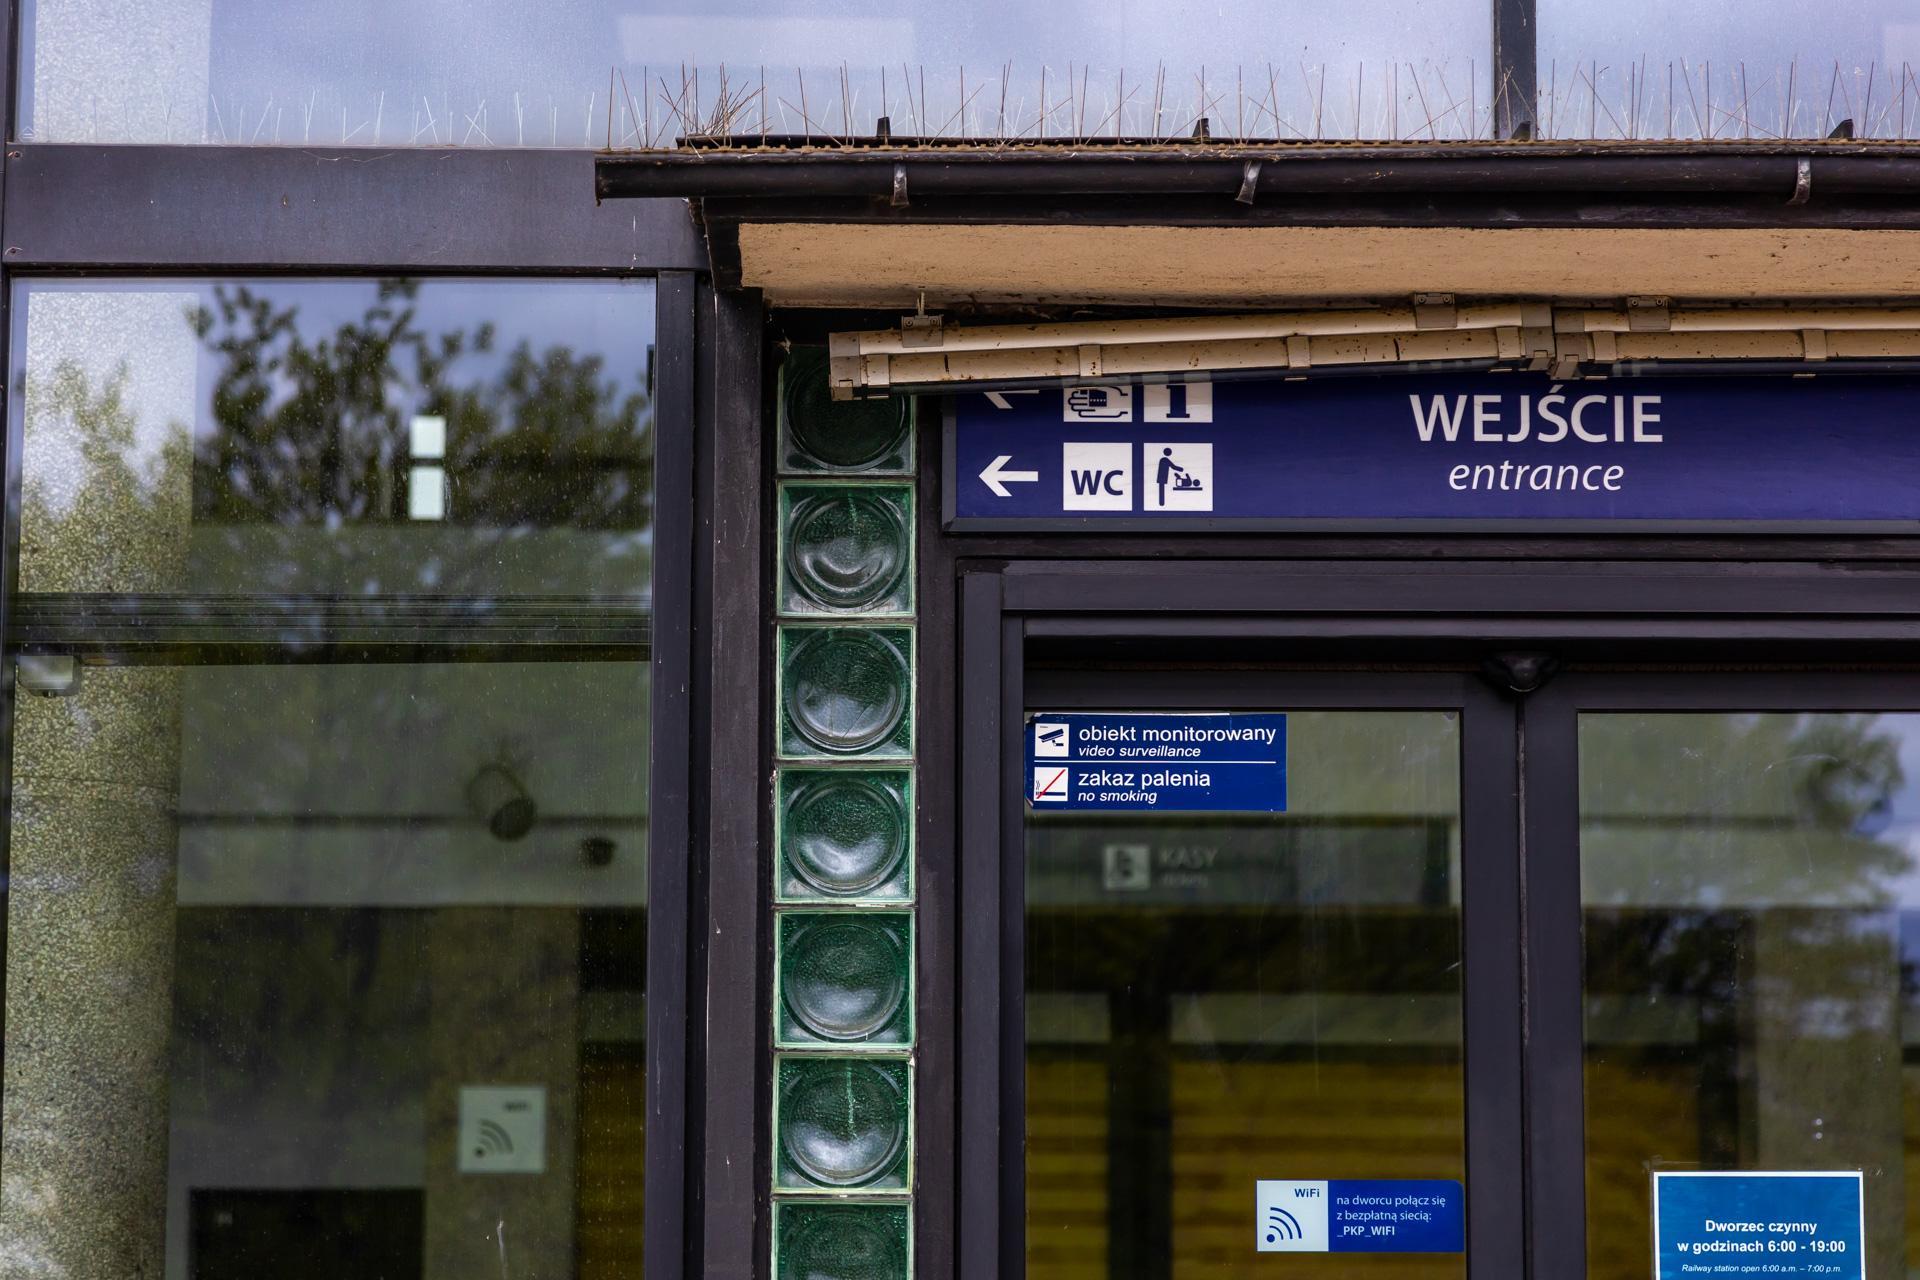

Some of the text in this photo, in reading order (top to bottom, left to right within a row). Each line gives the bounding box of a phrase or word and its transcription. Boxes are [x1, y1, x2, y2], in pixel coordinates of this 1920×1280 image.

[1409, 384, 1663, 443] WEJŚCIE
[1448, 459, 1625, 491] entrance
[1070, 469, 1124, 496] WC
[1079, 725, 1277, 745] obiekt monitorowany
[1078, 745, 1201, 758] video surveillance
[1078, 770, 1211, 790] zakaz palenia
[1077, 790, 1158, 805] no smoking
[1294, 1188, 1320, 1198] WiFi
[1336, 1195, 1446, 1208] na dworcu połącz się
[1336, 1210, 1432, 1223] z bezpłatną siecią:
[1336, 1226, 1396, 1238] _PKP_WIFI
[1705, 1219, 1818, 1235] Dworzec czynny
[1677, 1242, 1689, 1252] w
[1692, 1240, 1764, 1254] godzinach
[1767, 1240, 1797, 1252] 6:00
[1810, 1240, 1846, 1252] 19:00
[1681, 1264, 1713, 1274] Railway
[1714, 1264, 1739, 1273] station
[1740, 1266, 1760, 1274] open
[1807, 1264, 1824, 1273] 7:00
[1825, 1266, 1842, 1274] p.m.
